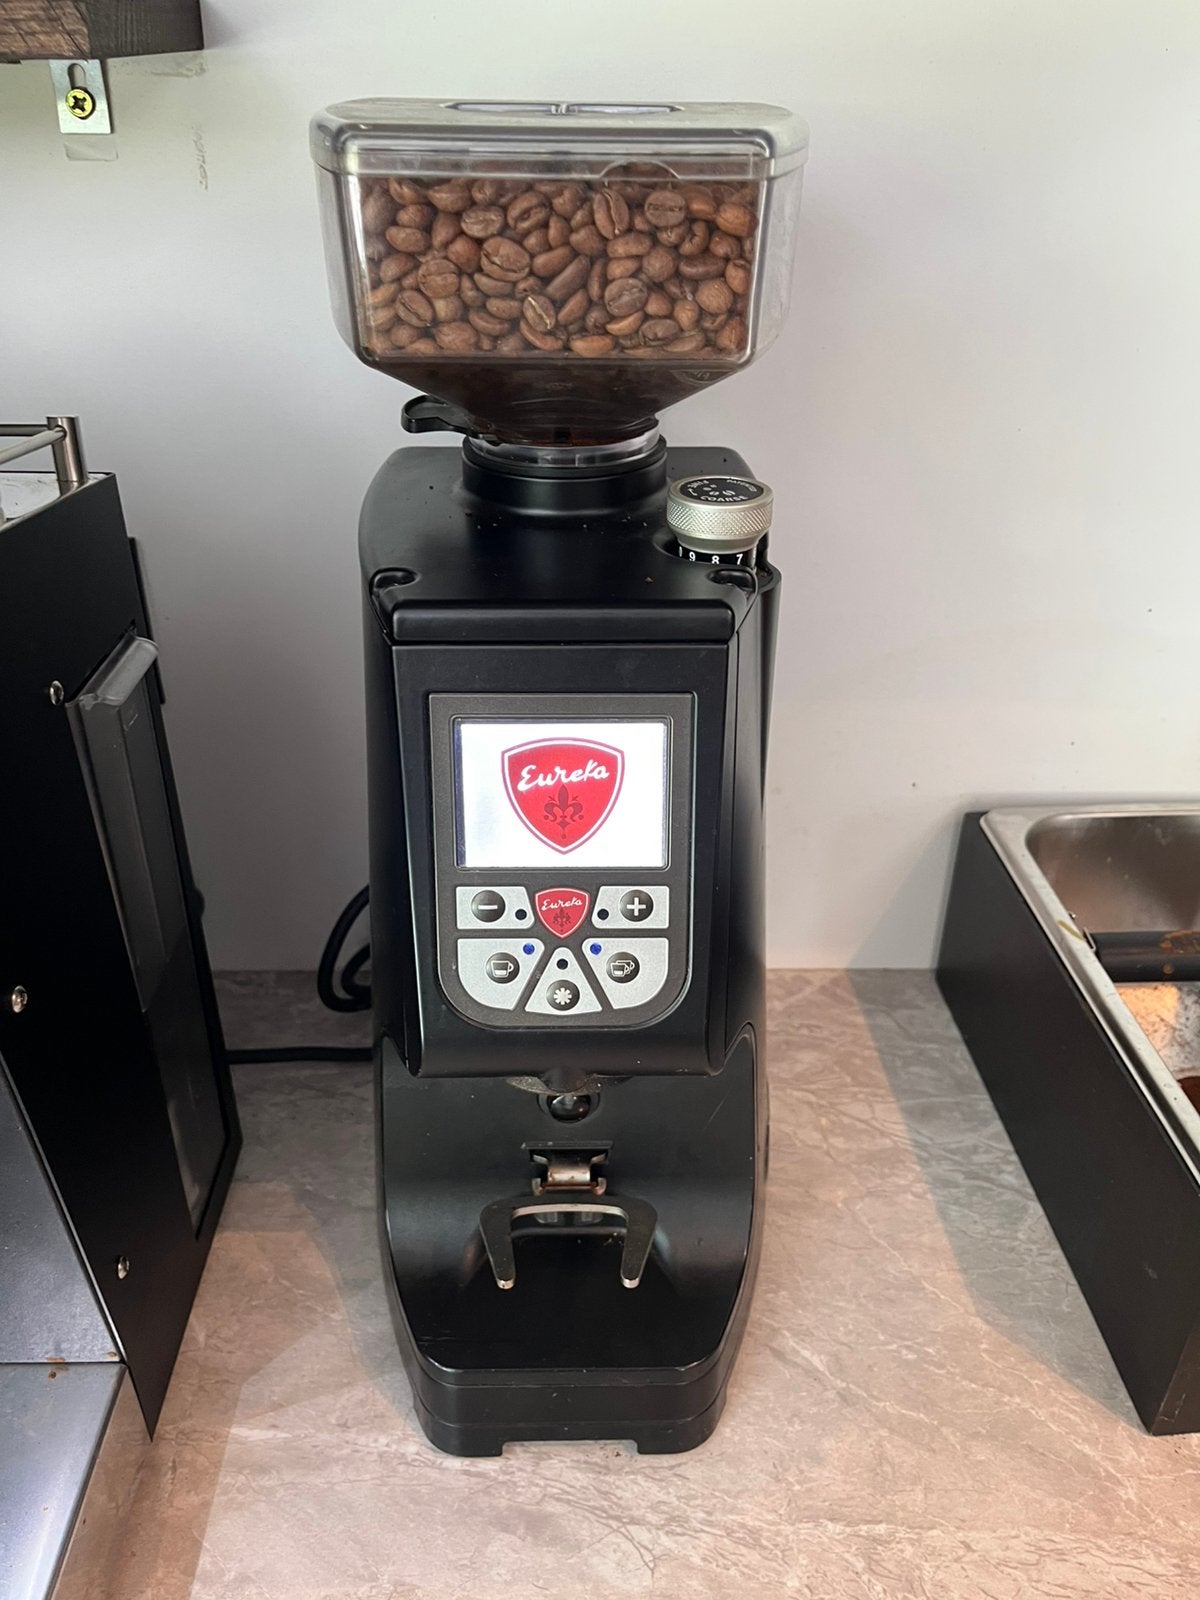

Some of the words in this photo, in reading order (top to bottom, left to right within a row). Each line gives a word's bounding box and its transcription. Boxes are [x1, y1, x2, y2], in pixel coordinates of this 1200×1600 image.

[689, 551, 696, 562] 9
[711, 555, 720, 565] 8
[736, 553, 744, 565] 7
[516, 759, 610, 793] Eureka
[541, 896, 583, 912] Eureka
